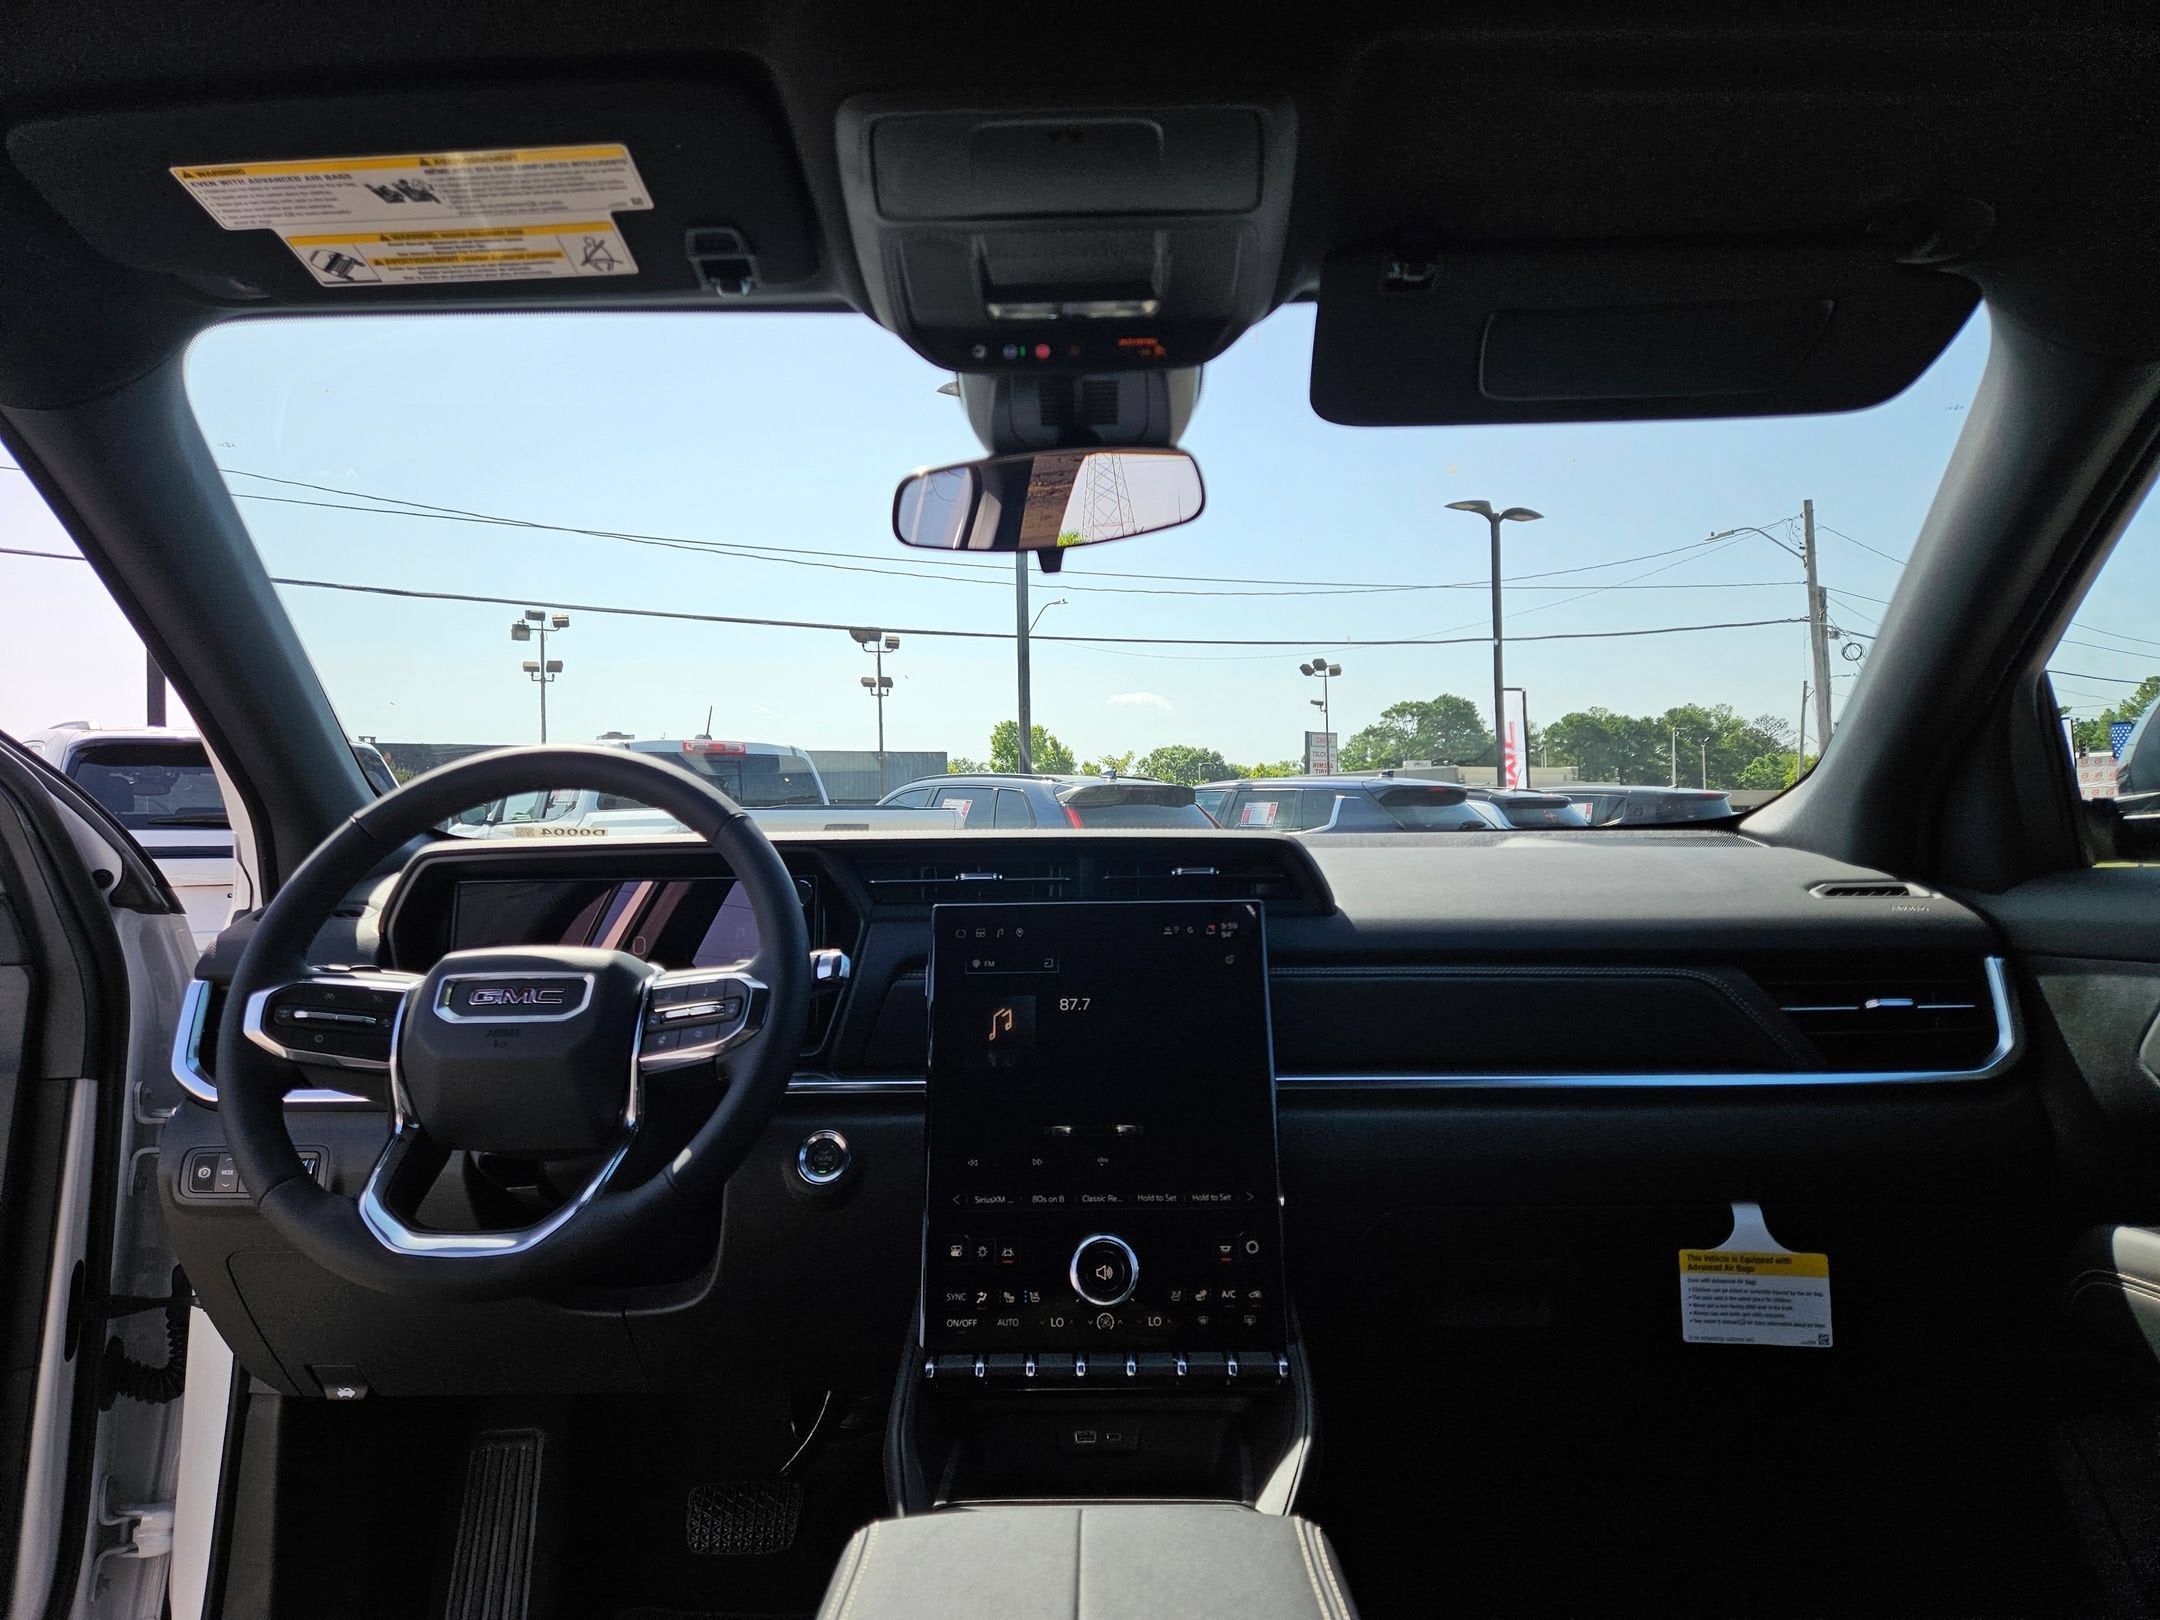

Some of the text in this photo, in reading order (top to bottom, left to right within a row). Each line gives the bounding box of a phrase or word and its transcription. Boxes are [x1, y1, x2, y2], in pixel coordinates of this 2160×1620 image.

[984, 960, 996, 968] FM
[468, 986, 564, 1006] GMC
[1059, 998, 1091, 1011] 87.7
[1032, 1195, 1047, 1203] 80s
[1082, 1194, 1106, 1203] Classic
[1137, 1194, 1177, 1202] Hold to Set
[1192, 1193, 1231, 1202] Hold to Set
[946, 1291, 967, 1301] SYNC
[1221, 1290, 1236, 1300] A/C
[946, 1318, 978, 1329] ON/OFF
[997, 1318, 1019, 1328] AUTO
[1050, 1317, 1064, 1328] LO
[1147, 1317, 1162, 1327] LO
